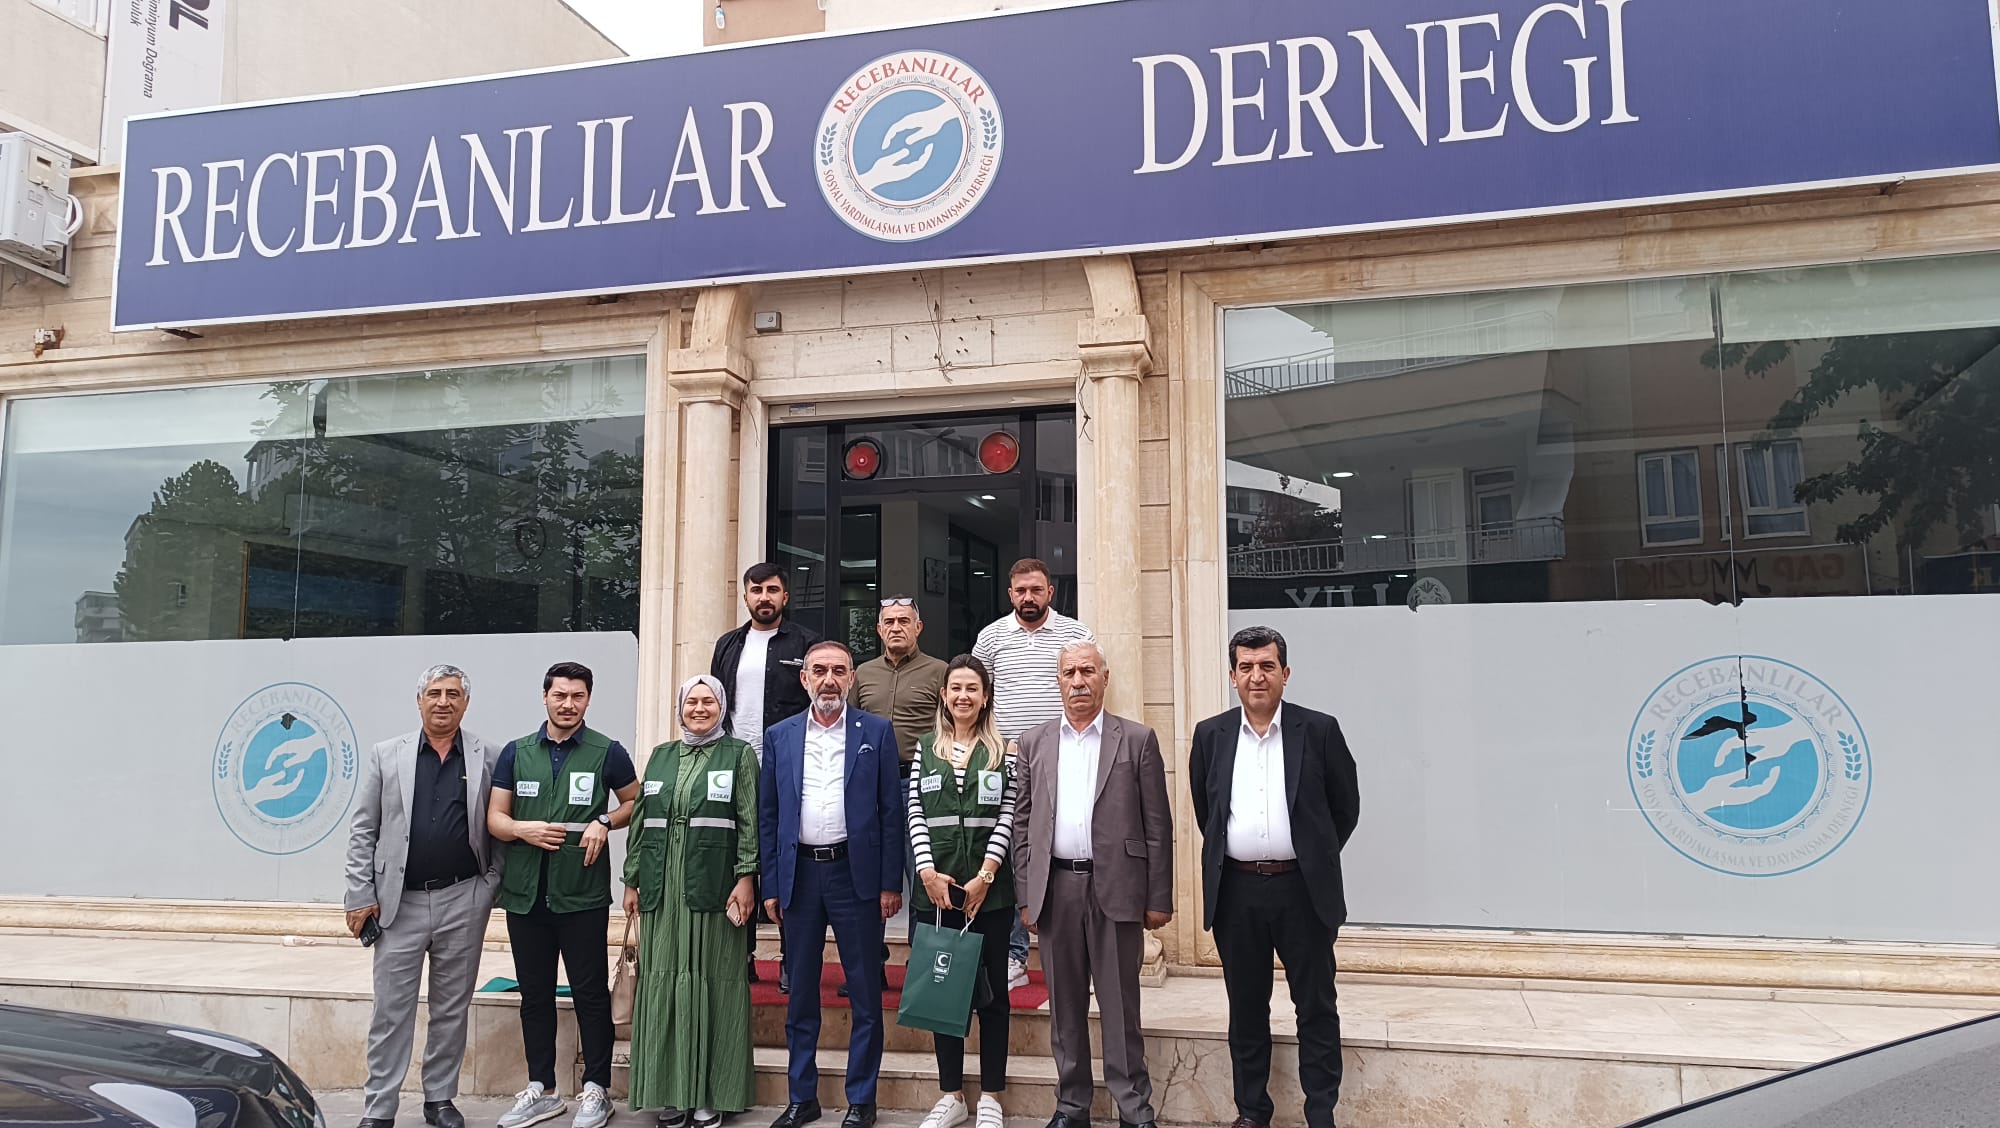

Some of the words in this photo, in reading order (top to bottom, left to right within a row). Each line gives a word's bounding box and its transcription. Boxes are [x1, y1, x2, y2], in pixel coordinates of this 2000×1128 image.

[142, 47, 158, 99] Doğrama
[832, 57, 986, 115] RECEBANLILAR
[145, 101, 787, 267] RECEBANLILAR
[822, 168, 844, 202] SOSYAL
[840, 198, 902, 236] YARDIMLAŞMA
[903, 222, 917, 234] VE
[917, 197, 971, 233] DAYANIŞMA
[966, 155, 994, 199] DERNEĞİ
[231, 689, 346, 737] RECEBANLILAR
[1650, 663, 1843, 725] RECEBANLILAR
[1748, 854, 1766, 868] VE
